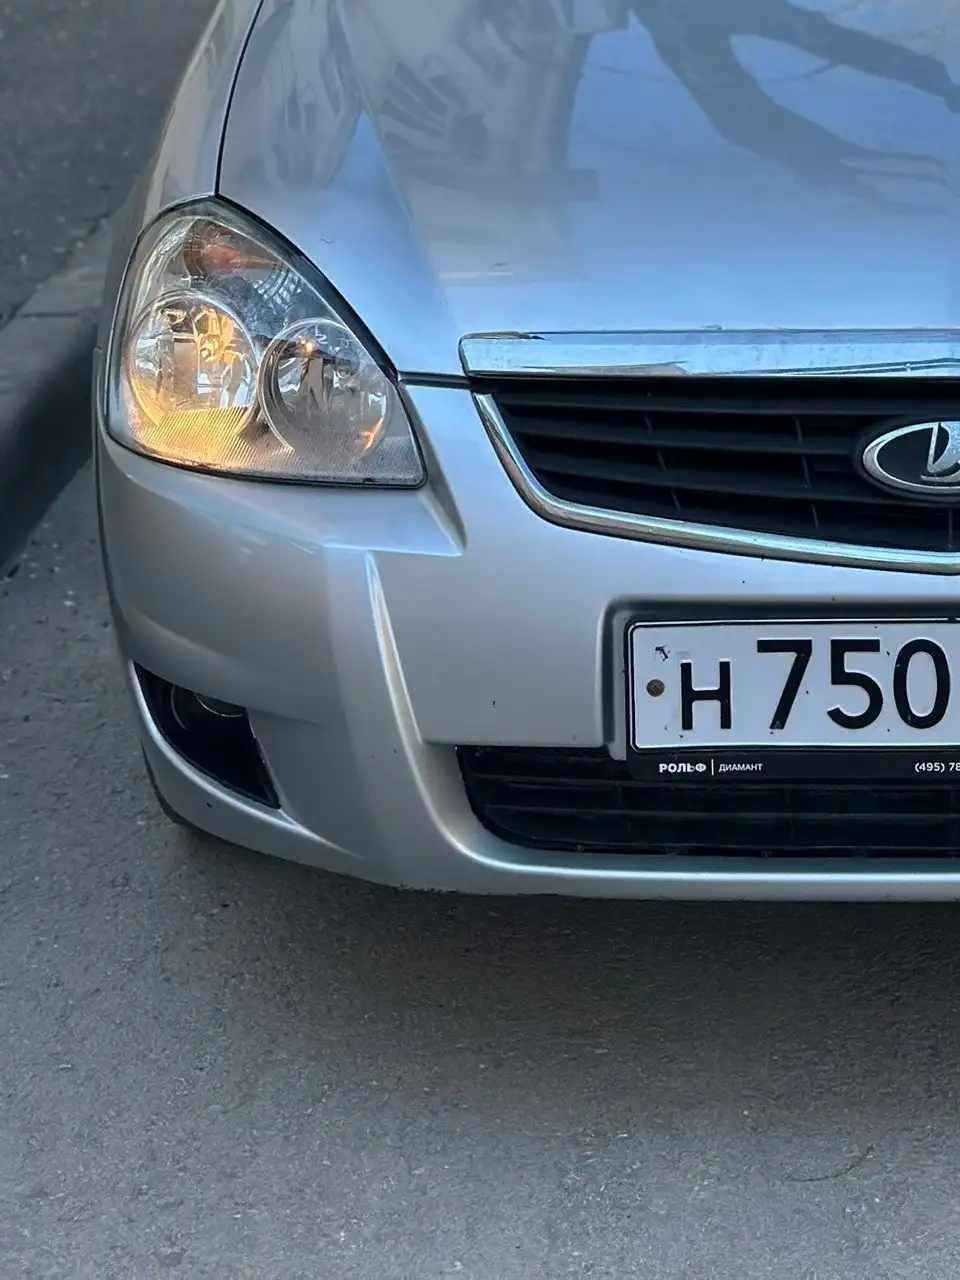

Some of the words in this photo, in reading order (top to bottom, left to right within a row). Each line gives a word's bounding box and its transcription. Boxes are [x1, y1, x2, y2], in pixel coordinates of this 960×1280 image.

[658, 762, 707, 774] РОЛЬФ
[718, 762, 764, 773] ДИАМАНТ
[914, 761, 946, 773] (495)
